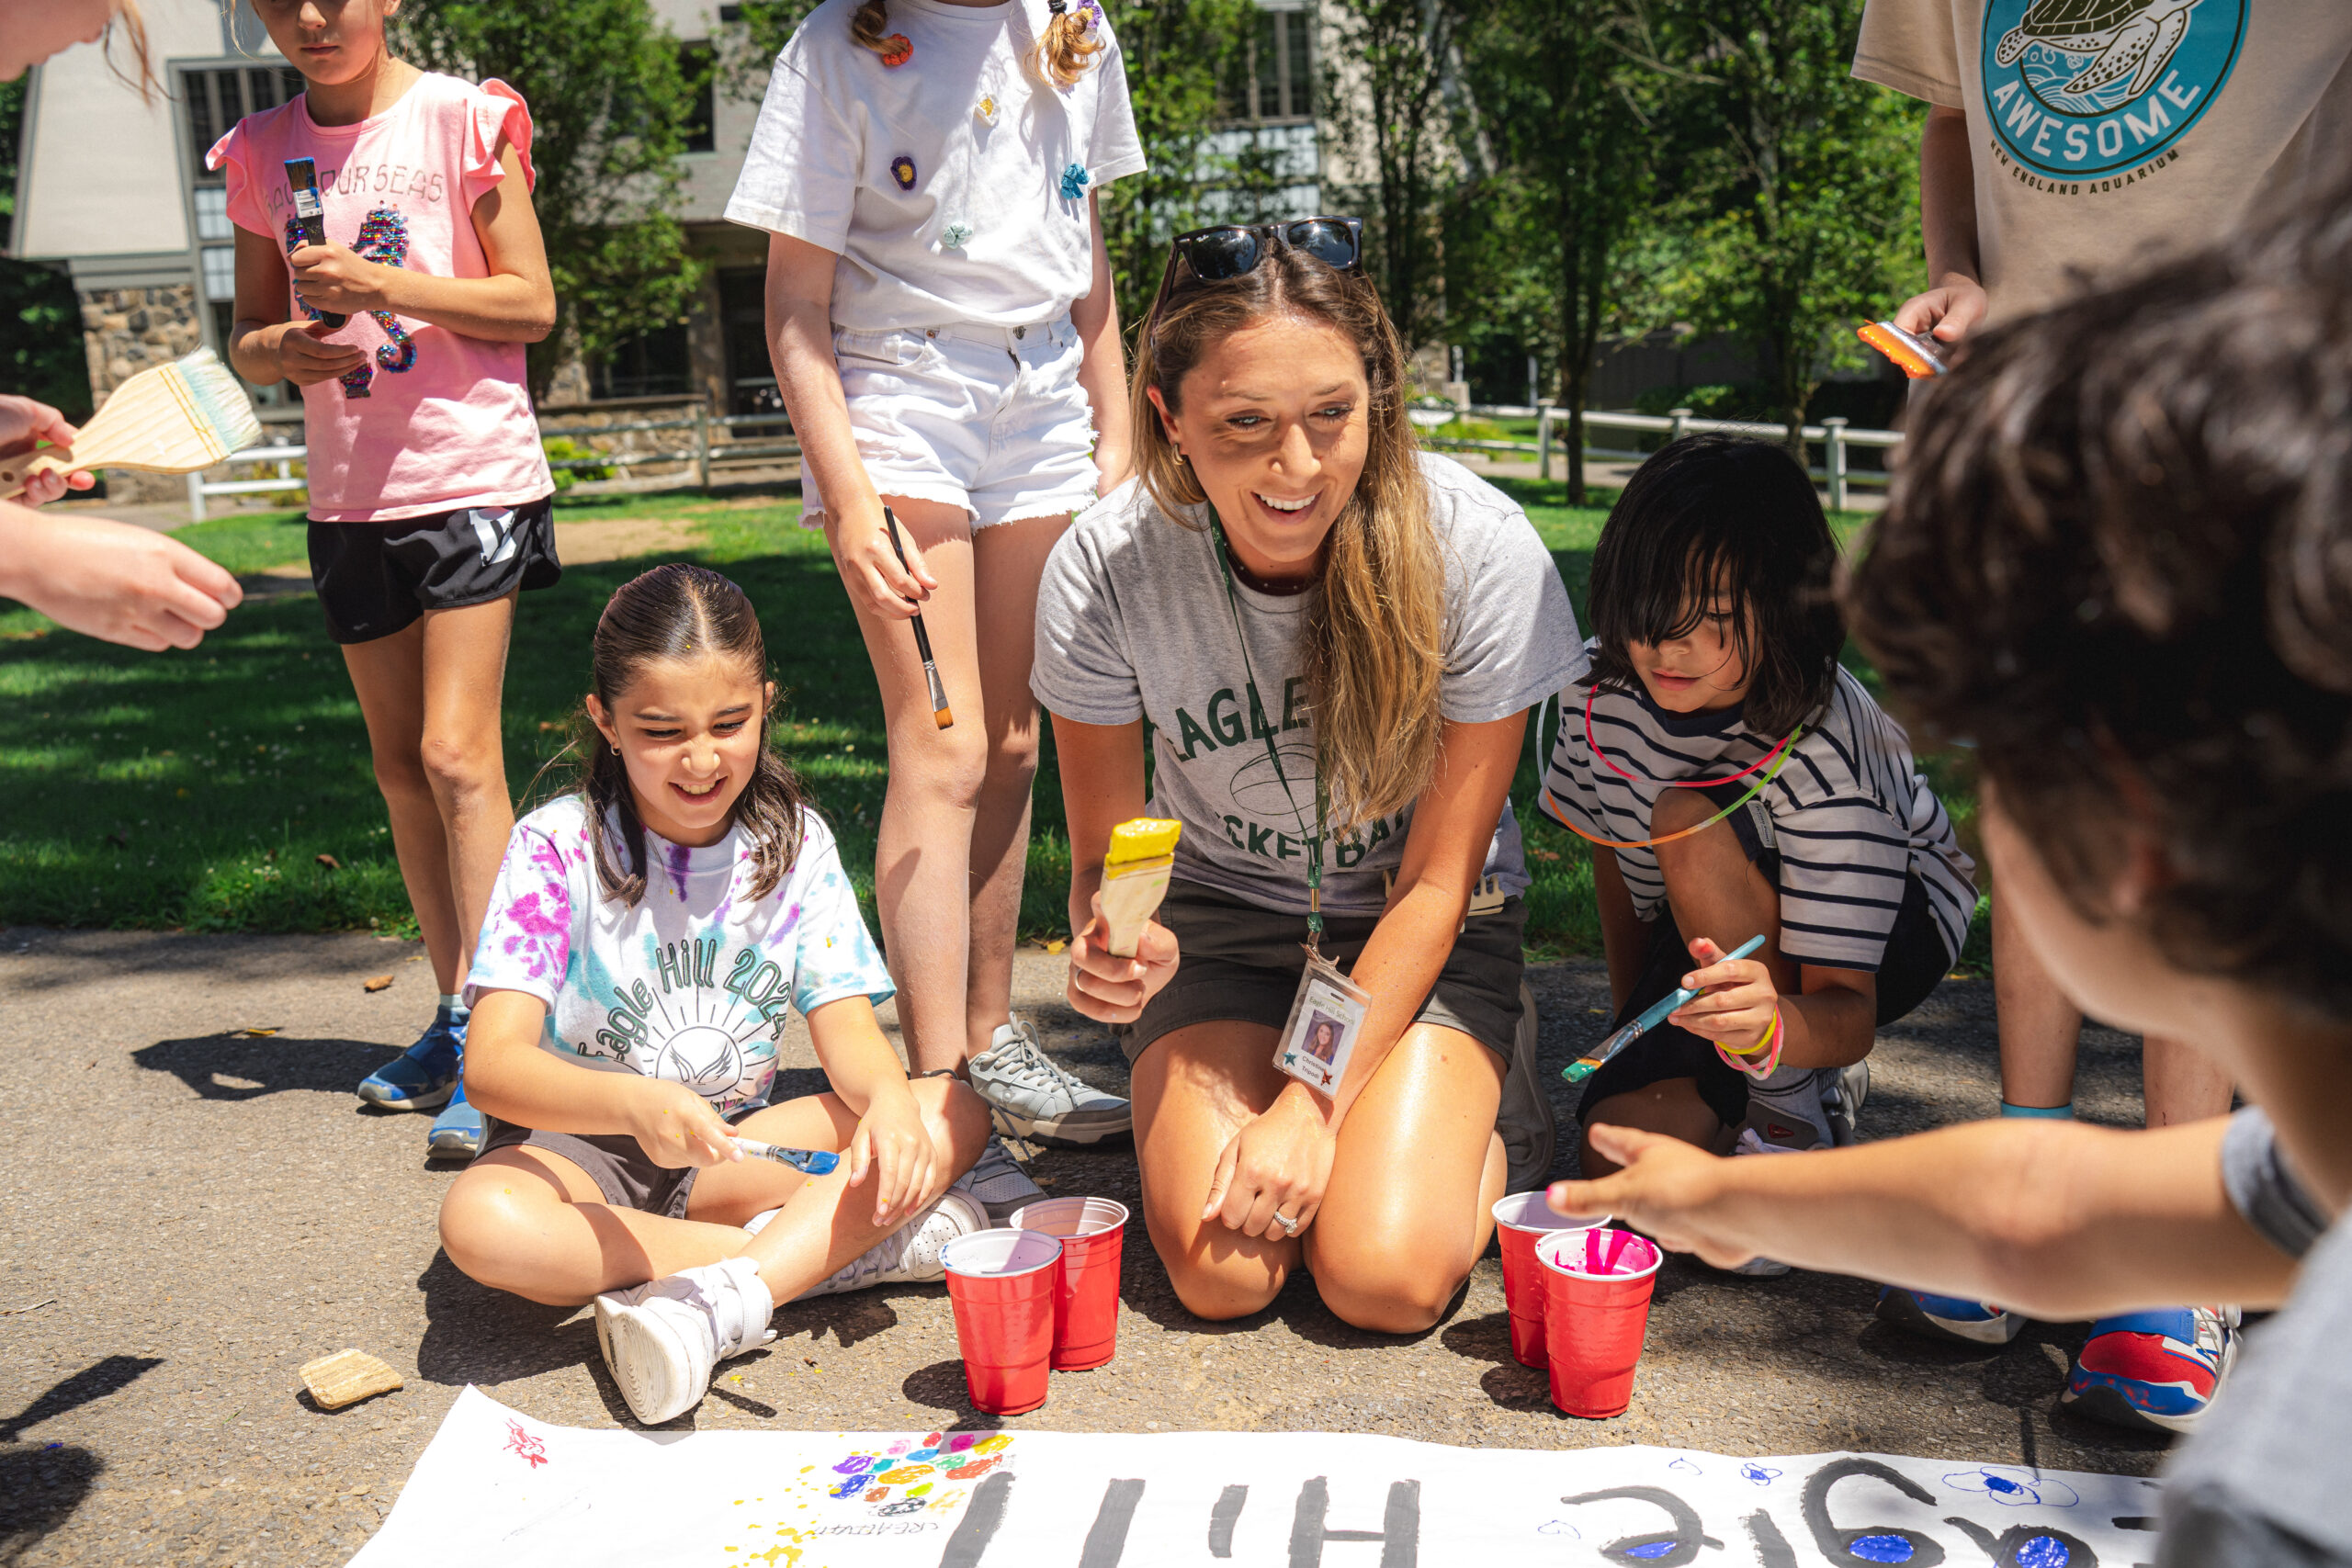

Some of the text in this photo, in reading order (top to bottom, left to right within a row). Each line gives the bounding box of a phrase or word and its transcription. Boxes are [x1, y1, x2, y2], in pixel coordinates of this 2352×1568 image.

[1992, 69, 2201, 162] AWESOME
[320, 164, 370, 197] OUR
[373, 164, 446, 203] SEAS
[1990, 139, 2180, 196] NEW ENGLAND AQUARIUM
[1154, 675, 1313, 762] AGLE
[655, 938, 718, 994] Hill
[1308, 996, 1356, 1025] Eagle Hill School
